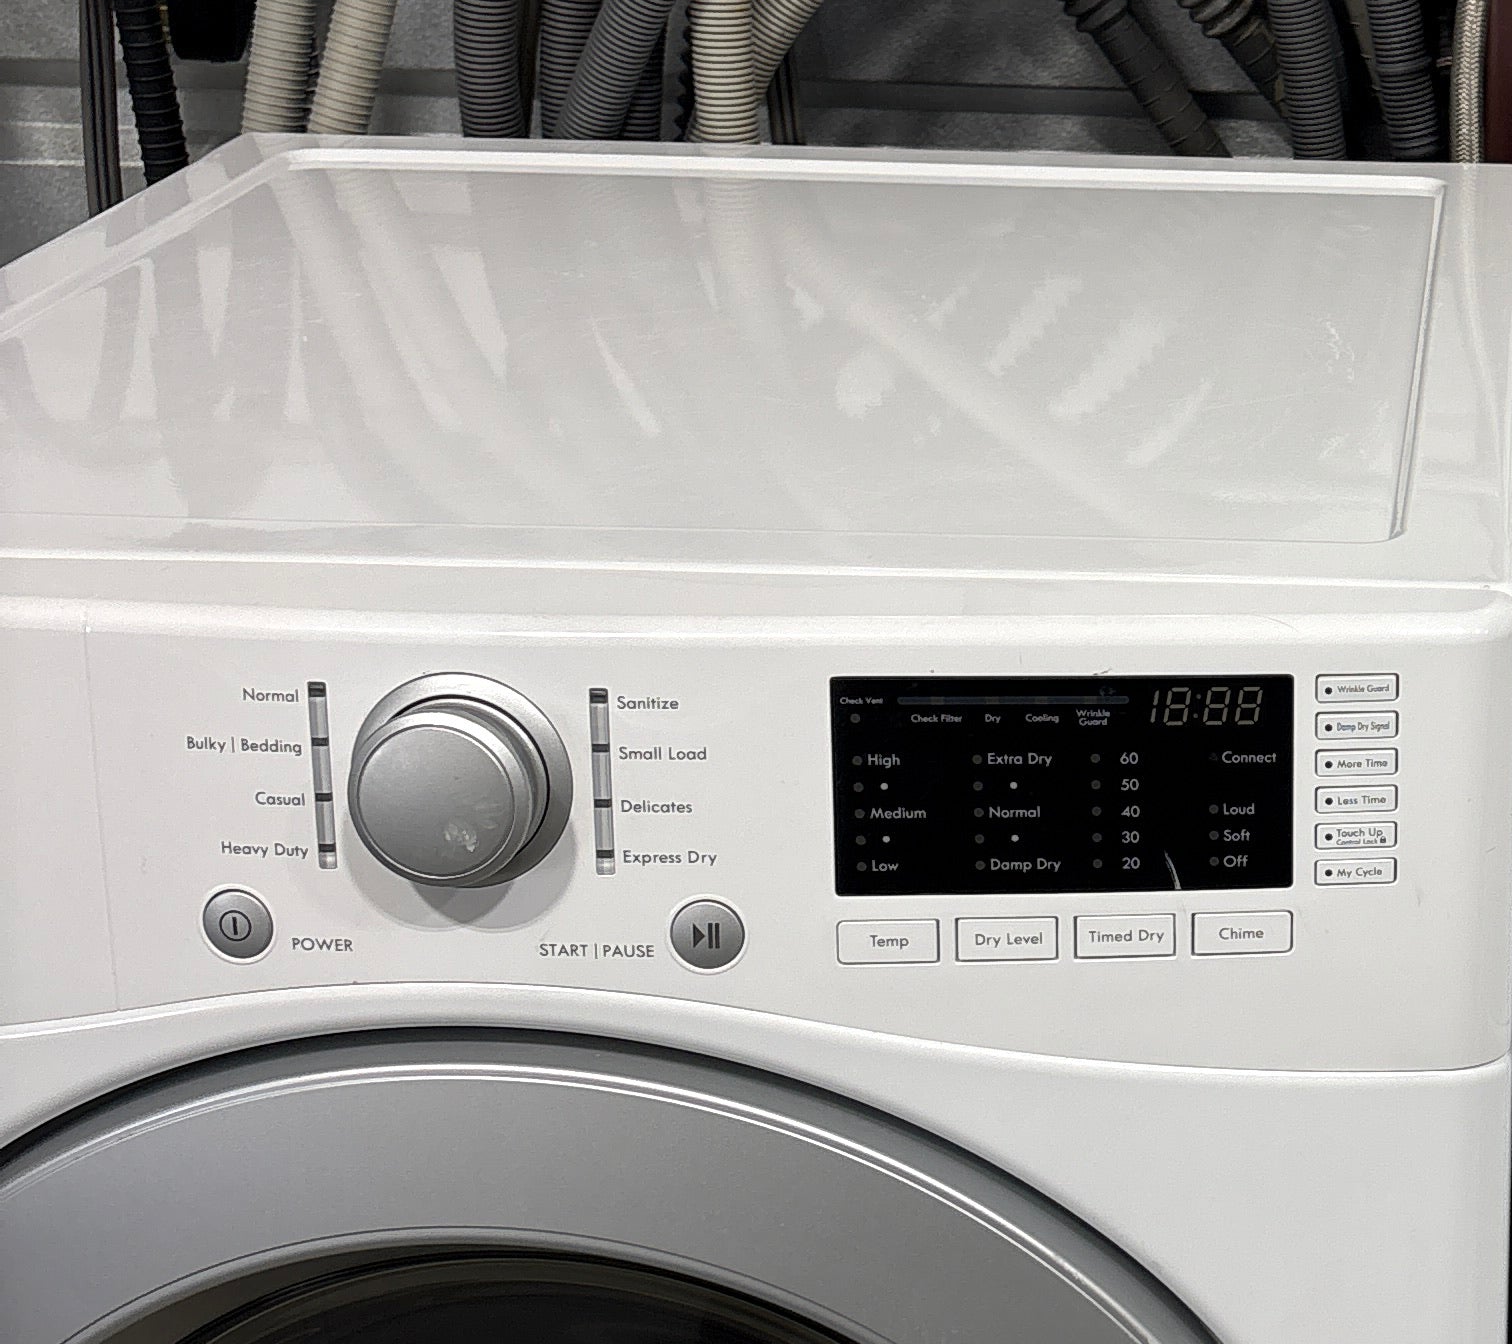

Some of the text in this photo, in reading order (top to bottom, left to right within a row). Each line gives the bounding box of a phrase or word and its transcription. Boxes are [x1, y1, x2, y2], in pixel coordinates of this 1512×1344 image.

[242, 687, 299, 703] Normal
[1336, 683, 1390, 694] Wrinkle Guard
[616, 695, 679, 710] Sanitize
[839, 696, 884, 705] Check Vent
[910, 713, 963, 723] Check Filter
[984, 713, 1001, 724] Dry
[1025, 713, 1060, 724] Cooling
[1075, 708, 1111, 718] Wrinkle
[1078, 718, 1108, 727] Guard
[1336, 720, 1391, 733] Damp Dry Signal
[186, 735, 303, 757] Bulky Bedding
[618, 746, 707, 761] Small Load
[987, 752, 1053, 767] Extra Dry
[1119, 751, 1139, 765] 60
[1221, 750, 1277, 764] Connect
[867, 753, 901, 769] High
[1336, 758, 1389, 769] More Time
[1120, 778, 1140, 791] 50
[254, 791, 306, 807] Casual
[1337, 794, 1387, 806] Less Time
[620, 799, 693, 814] Delicates
[869, 806, 927, 820] Medium
[988, 805, 1041, 819] Normal
[1120, 805, 1141, 818] 40
[1222, 802, 1255, 816] Loud
[1121, 830, 1140, 844] 30
[1223, 828, 1251, 842] Soft
[1335, 827, 1384, 838] Touch Up
[220, 840, 309, 860] Heavy Duty
[622, 849, 718, 867] Express Dry
[1121, 856, 1141, 870] 20
[1223, 854, 1249, 868] Off
[871, 859, 899, 872] Low
[990, 857, 1062, 874] Damp Dry
[1336, 866, 1383, 879] My Cycle
[974, 931, 1043, 949] Dry Level
[1088, 929, 1165, 944] Timed Dry
[1218, 927, 1265, 941] Chime
[291, 937, 354, 952] POWER
[869, 934, 910, 951] Temp
[539, 943, 655, 958] START PAUSE
